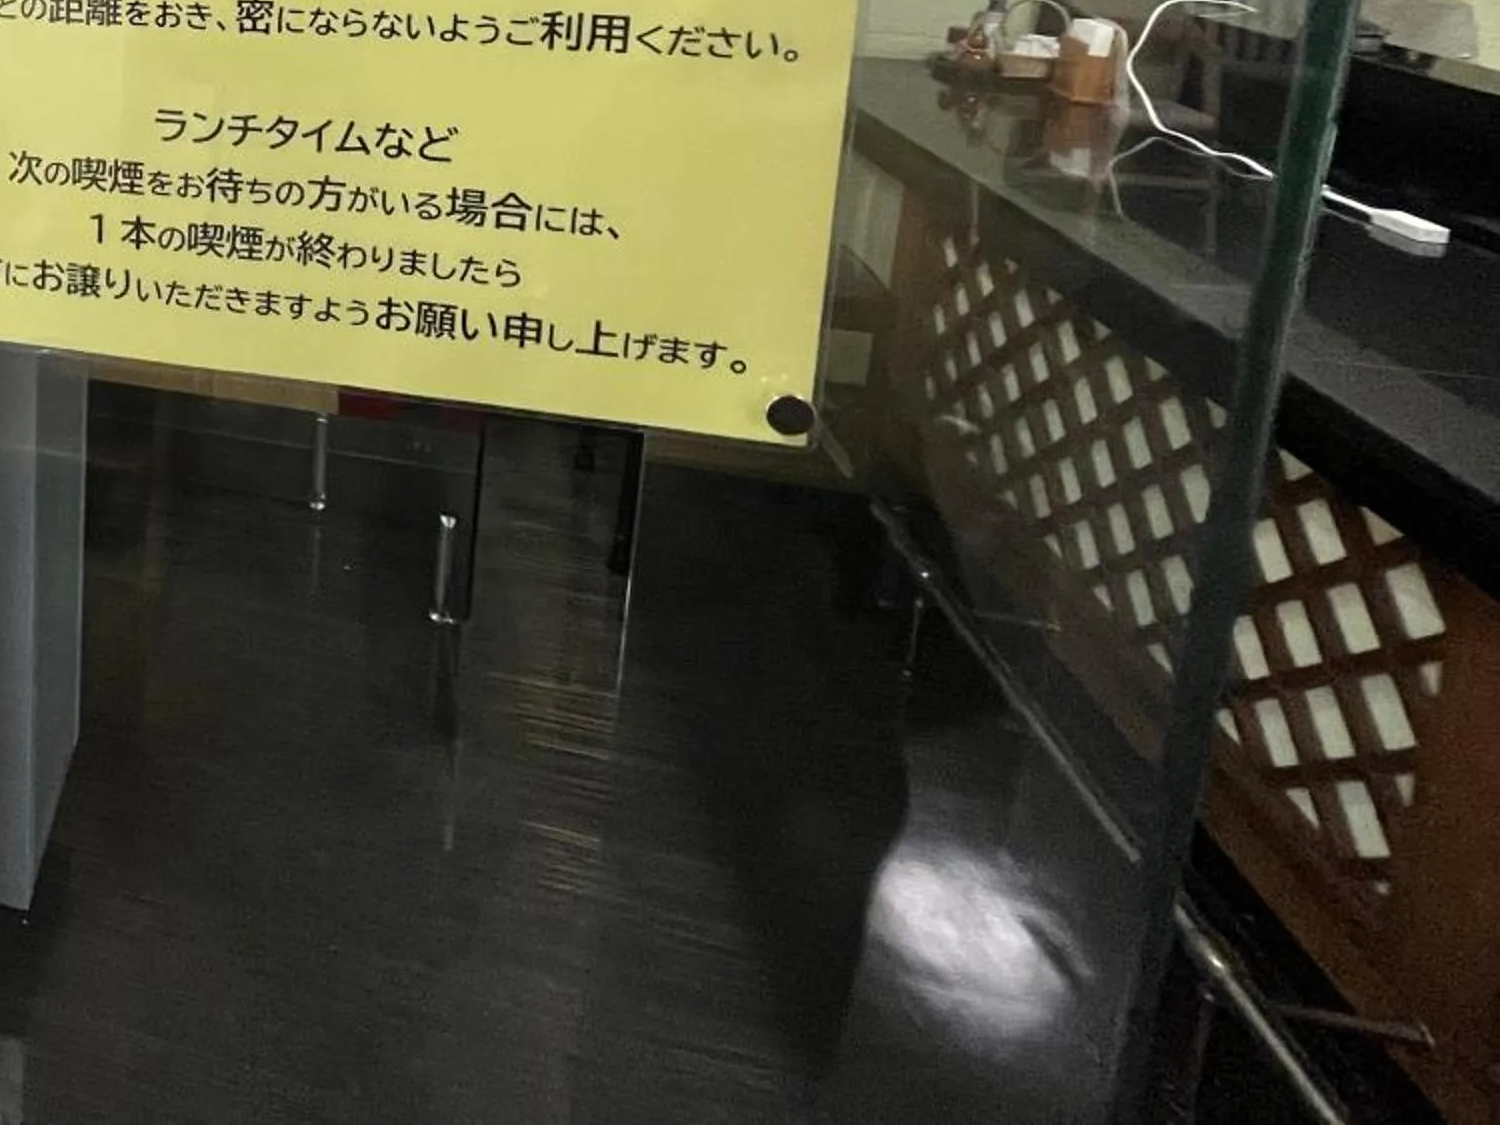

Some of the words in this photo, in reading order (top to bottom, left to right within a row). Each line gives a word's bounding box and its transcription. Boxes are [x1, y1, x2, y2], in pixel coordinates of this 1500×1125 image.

[155, 108, 459, 164] ランチタイムなど
[8, 150, 621, 241] 次の喫煙をお待ちの方がいる場合には、
